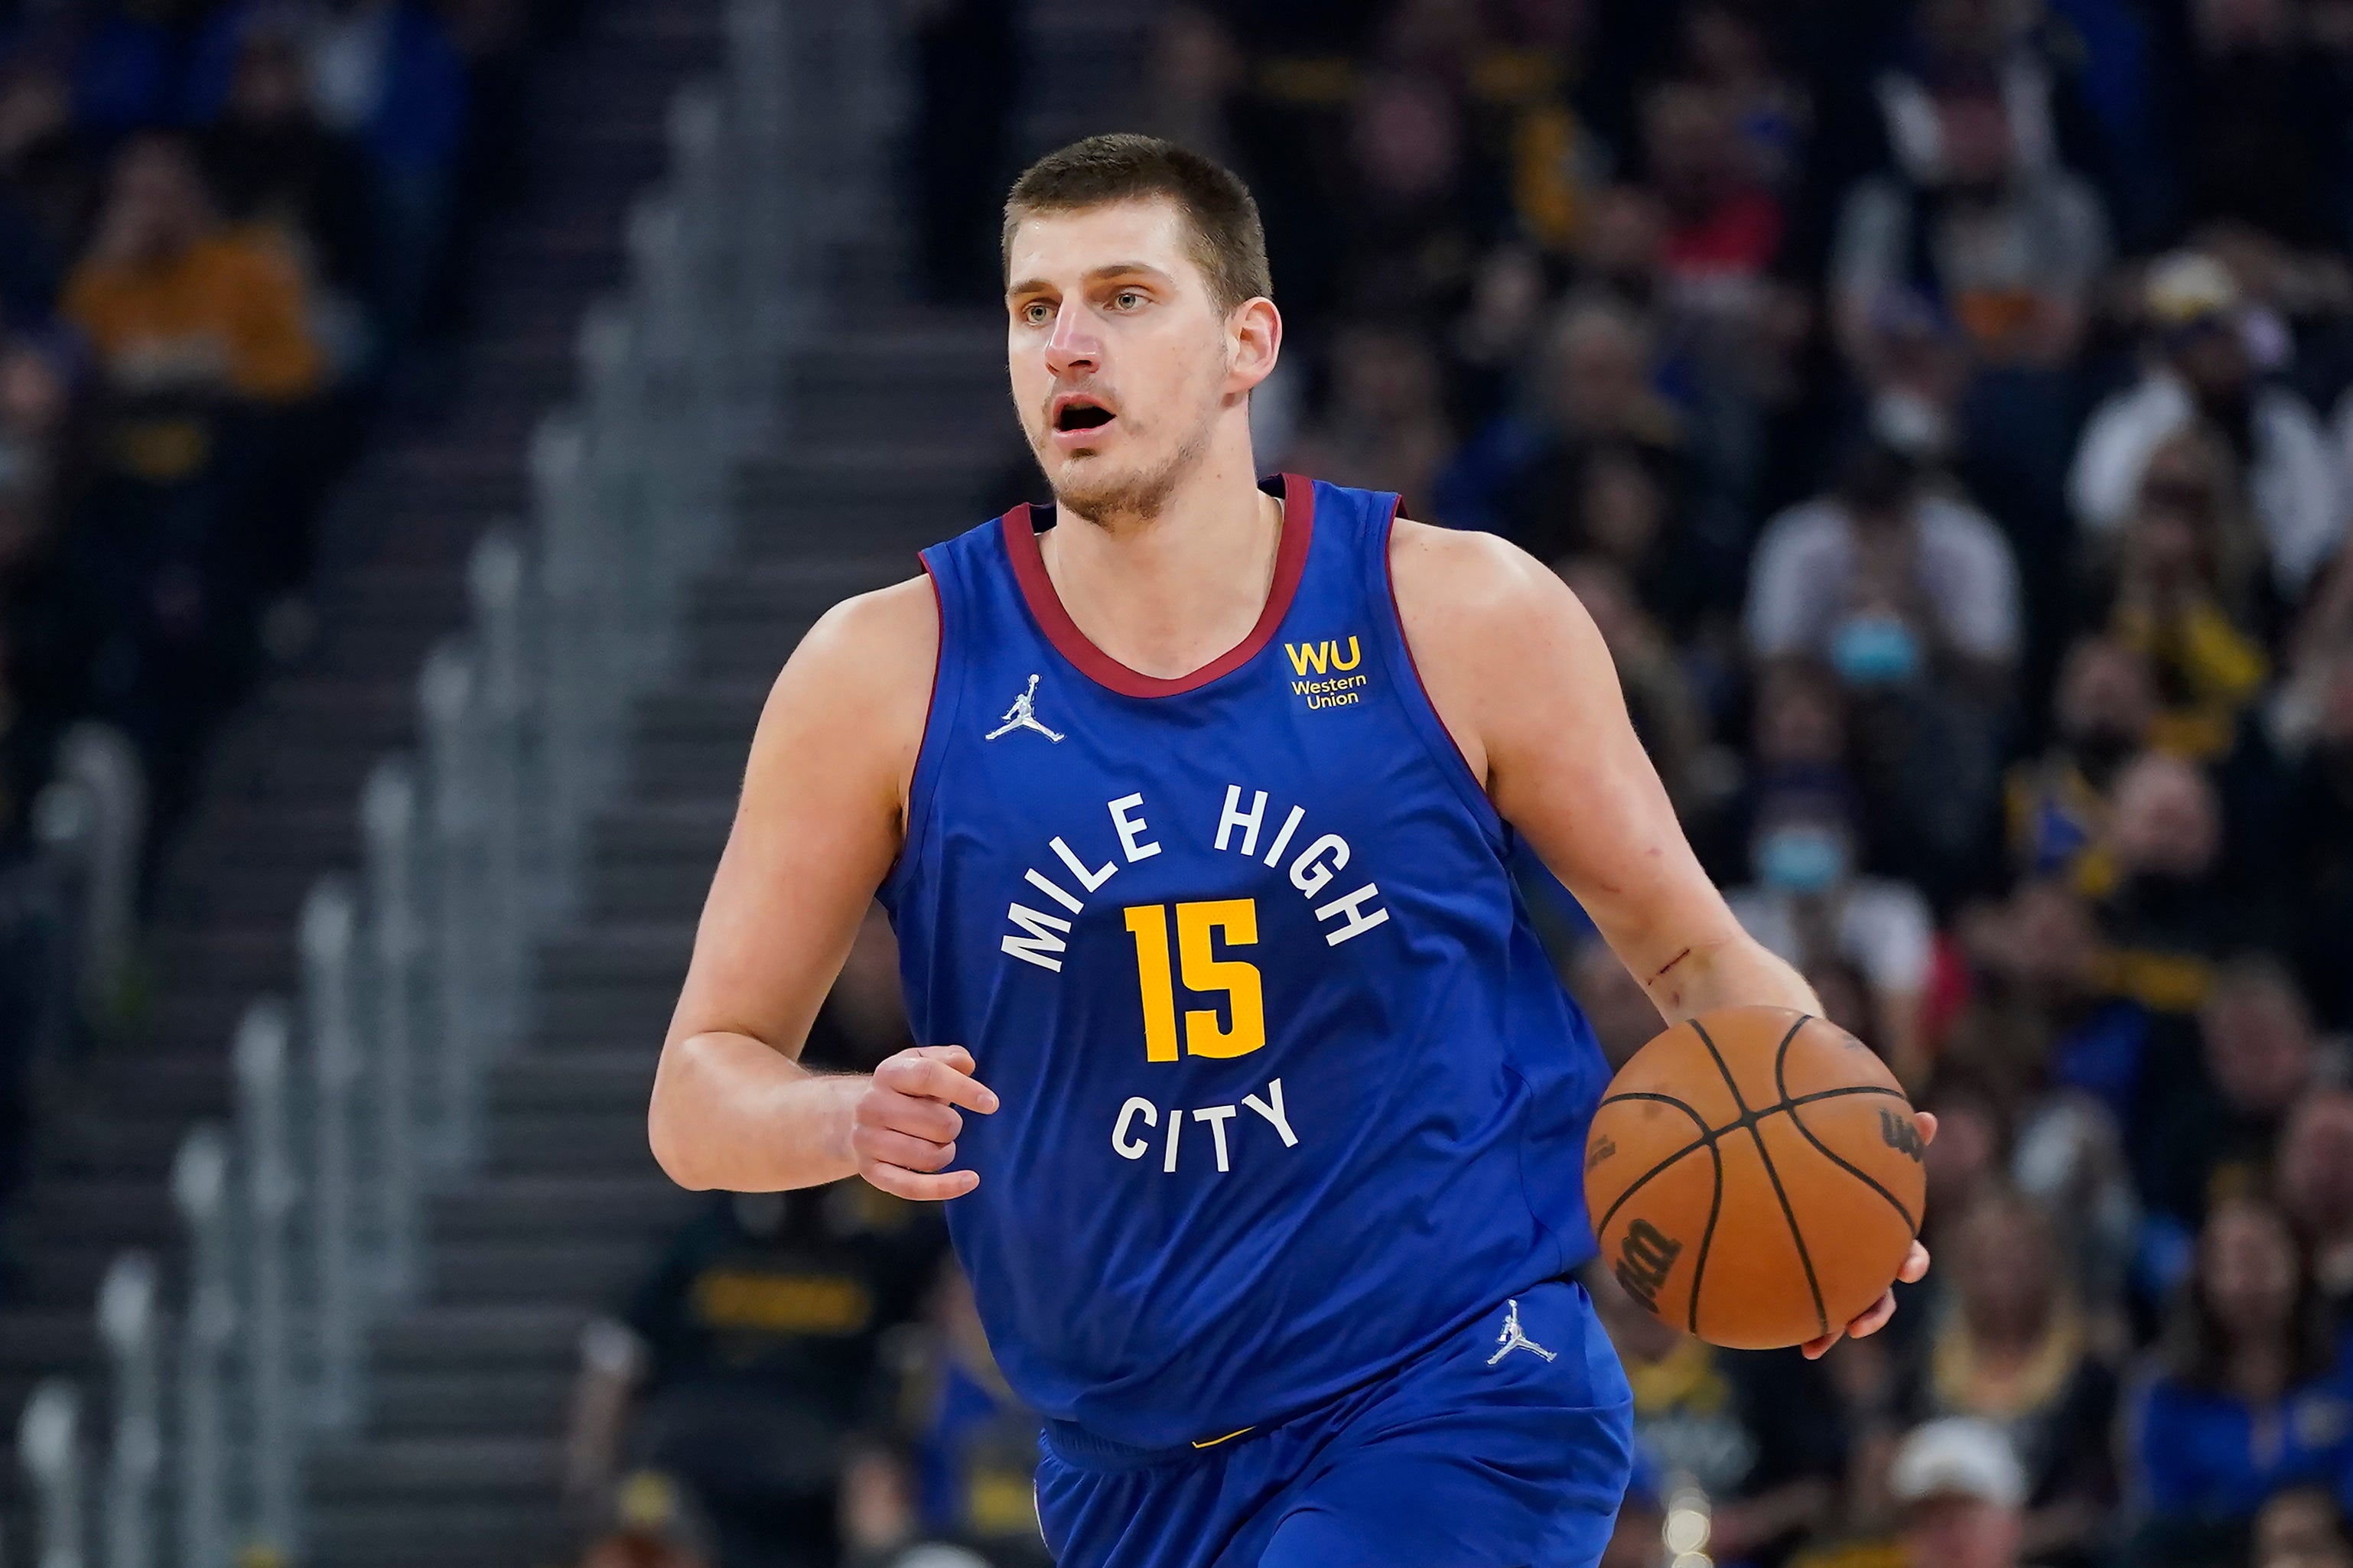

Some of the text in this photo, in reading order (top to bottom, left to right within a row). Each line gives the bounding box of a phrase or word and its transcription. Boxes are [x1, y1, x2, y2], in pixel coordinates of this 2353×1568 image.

[1284, 636, 1361, 676] WU
[1291, 674, 1367, 695] Western
[1307, 691, 1359, 710] Union
[1001, 785, 1389, 972] MILE HIGH
[1124, 899, 1265, 1062] 15
[1112, 1078, 1298, 1172] CITY
